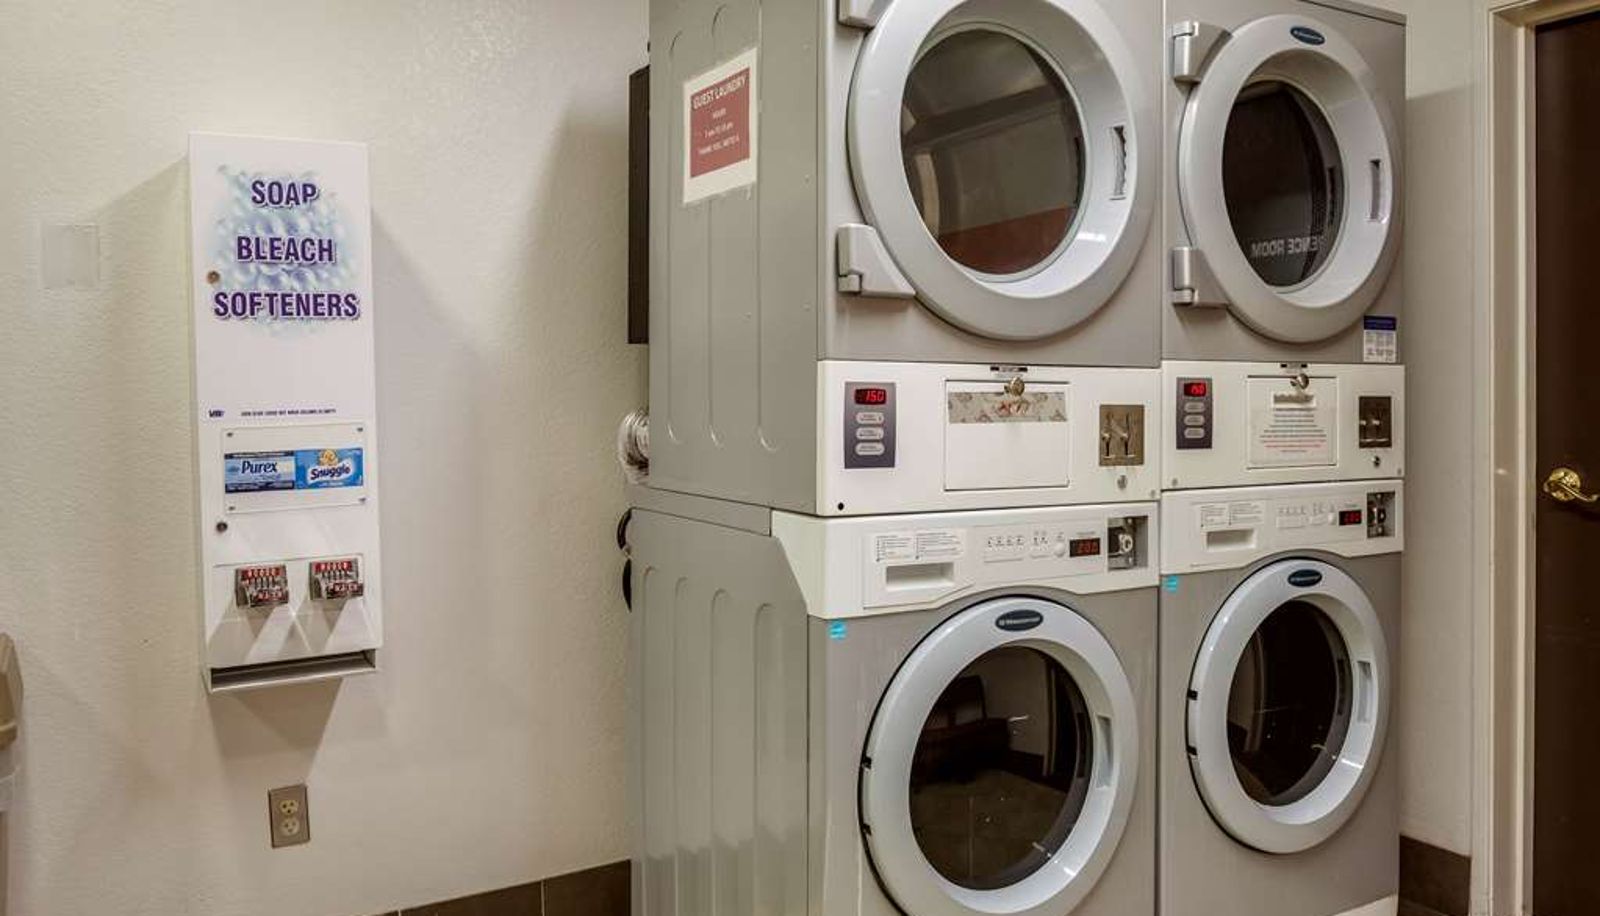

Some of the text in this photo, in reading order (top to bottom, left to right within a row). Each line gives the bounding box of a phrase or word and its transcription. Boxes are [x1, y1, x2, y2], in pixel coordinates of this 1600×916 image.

[693, 75, 746, 110] GUEST LAUNDRY
[252, 179, 318, 206] SOAP
[236, 236, 335, 263] BLEACH
[213, 291, 360, 320] SOFTENERS
[241, 460, 278, 475] Purex
[310, 463, 351, 481] Snuggle
